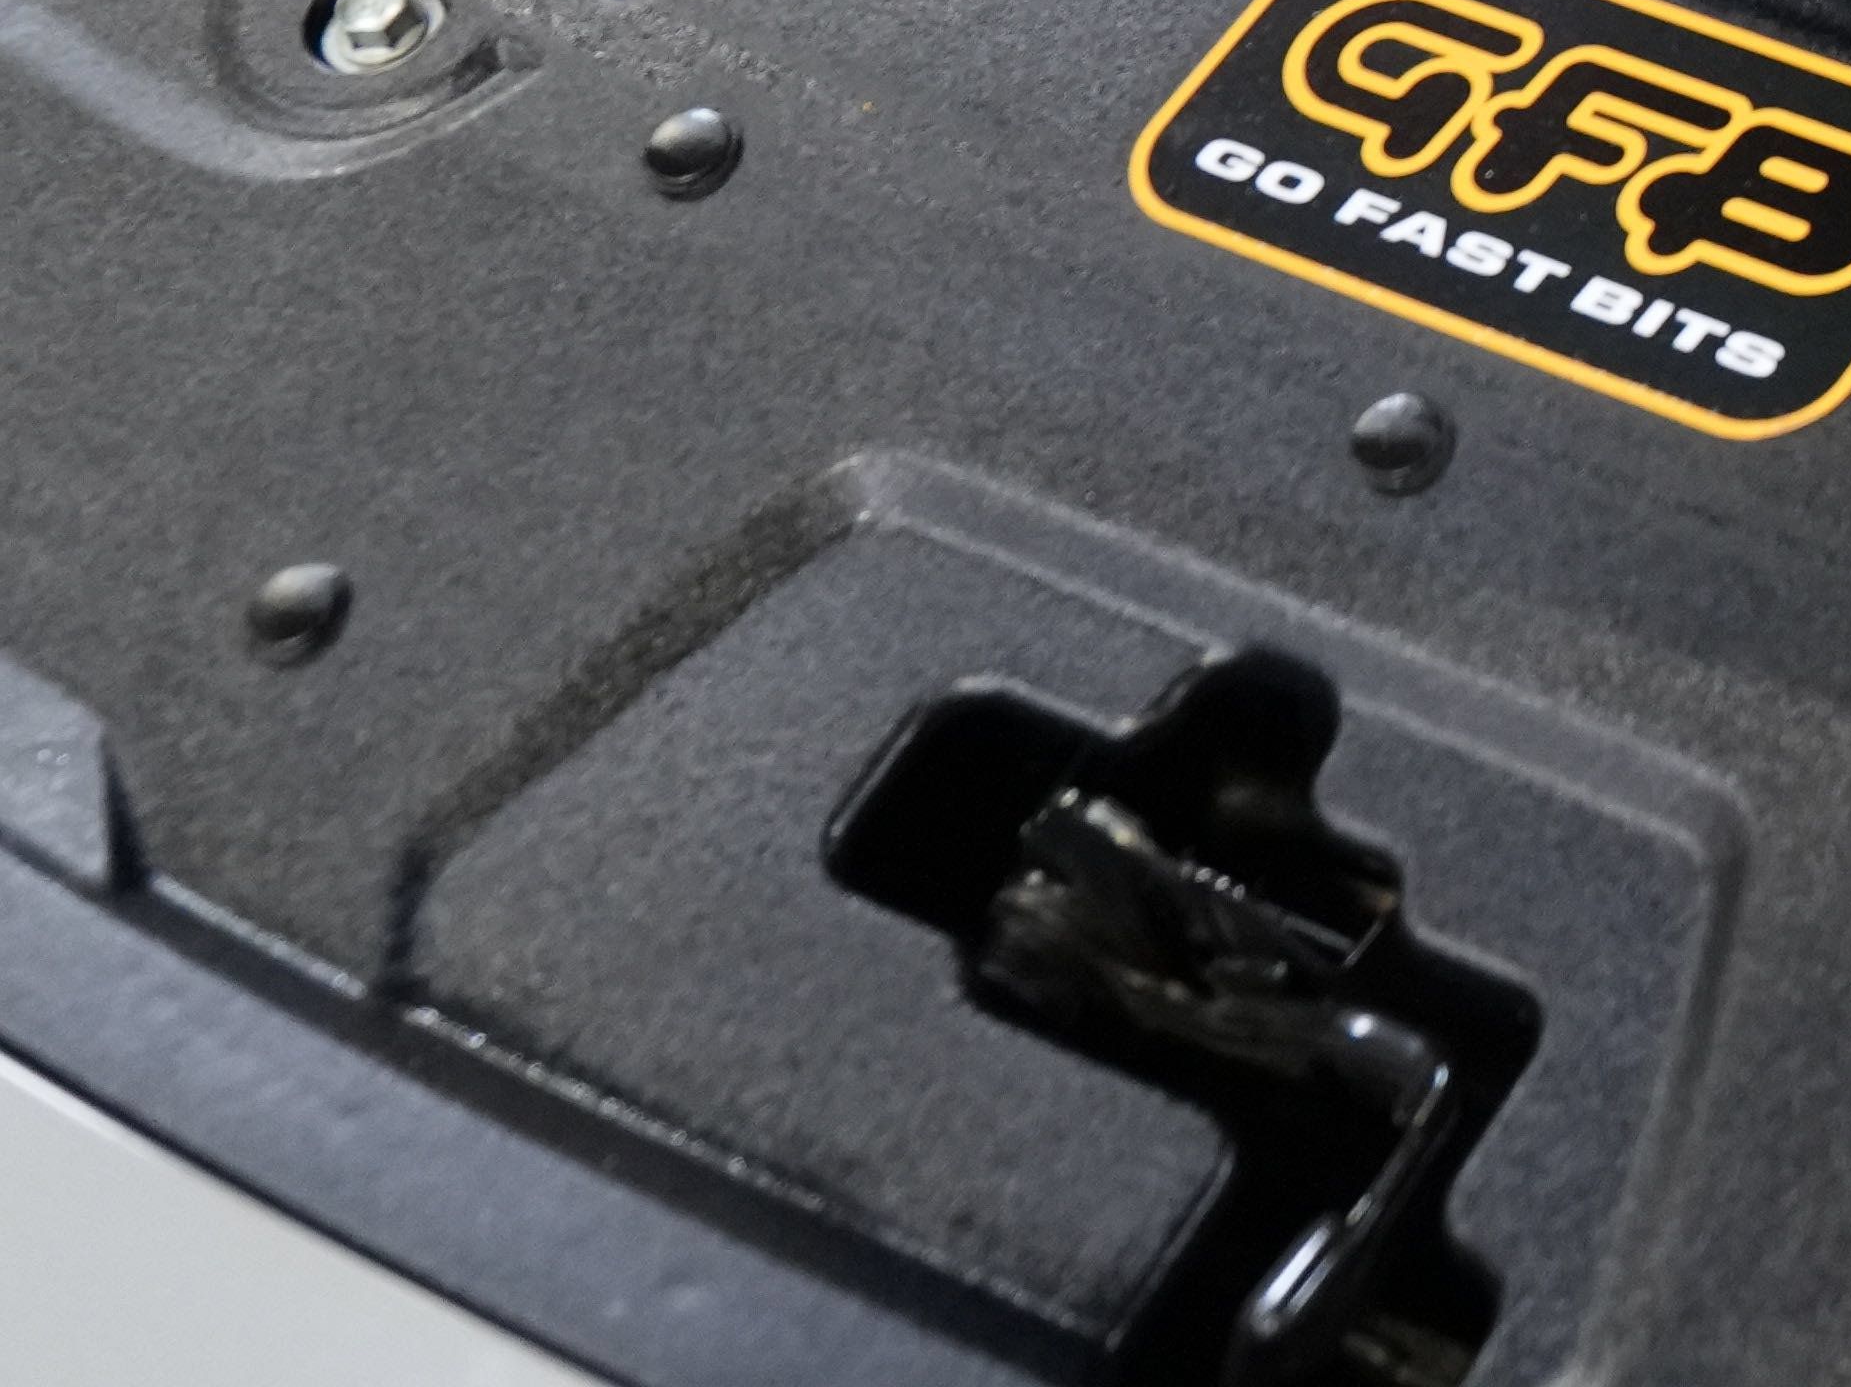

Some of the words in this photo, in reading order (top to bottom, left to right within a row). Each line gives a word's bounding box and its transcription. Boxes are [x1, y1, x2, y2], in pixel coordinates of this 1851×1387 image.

[1194, 136, 1326, 206] GO
[1333, 187, 1573, 296] FAST
[1569, 273, 1786, 380] BITS
